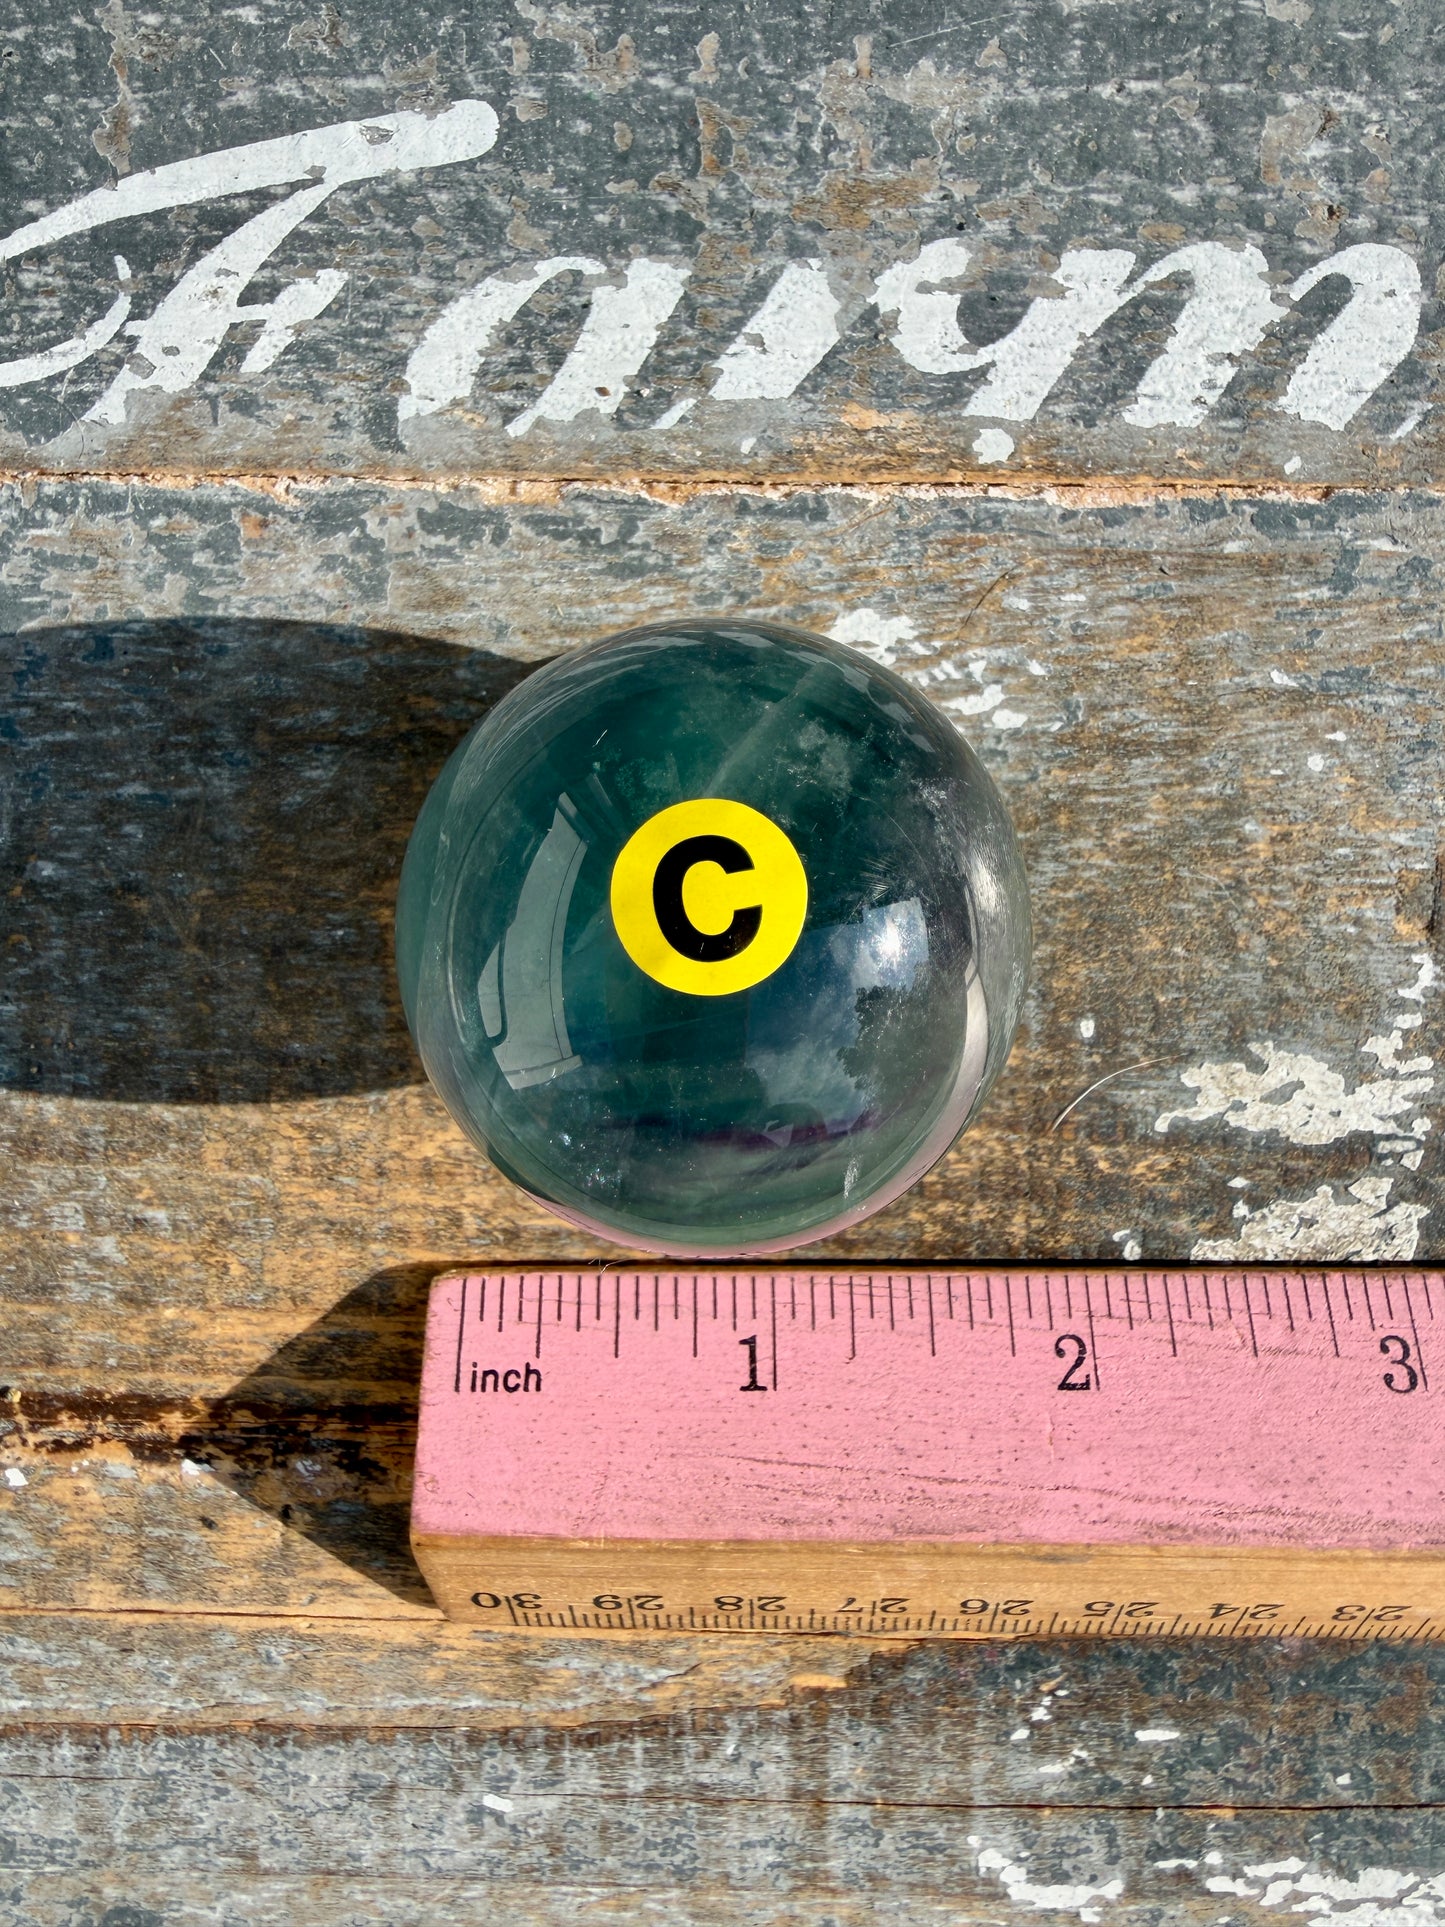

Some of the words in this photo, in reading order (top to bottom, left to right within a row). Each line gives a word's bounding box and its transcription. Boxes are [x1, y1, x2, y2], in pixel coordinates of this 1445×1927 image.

[652, 833, 763, 963] C
[470, 1361, 542, 1393] inch
[738, 1335, 768, 1392] 1
[1054, 1334, 1091, 1391] 2
[1379, 1335, 1418, 1394] 3
[470, 1591, 543, 1611] 30
[592, 1594, 665, 1611] 29
[714, 1595, 787, 1613] 28
[838, 1597, 915, 1614] 27
[959, 1598, 1035, 1617] 26
[1084, 1600, 1160, 1618] 25
[1209, 1602, 1286, 1621] 24
[1331, 1604, 1413, 1623] 23
